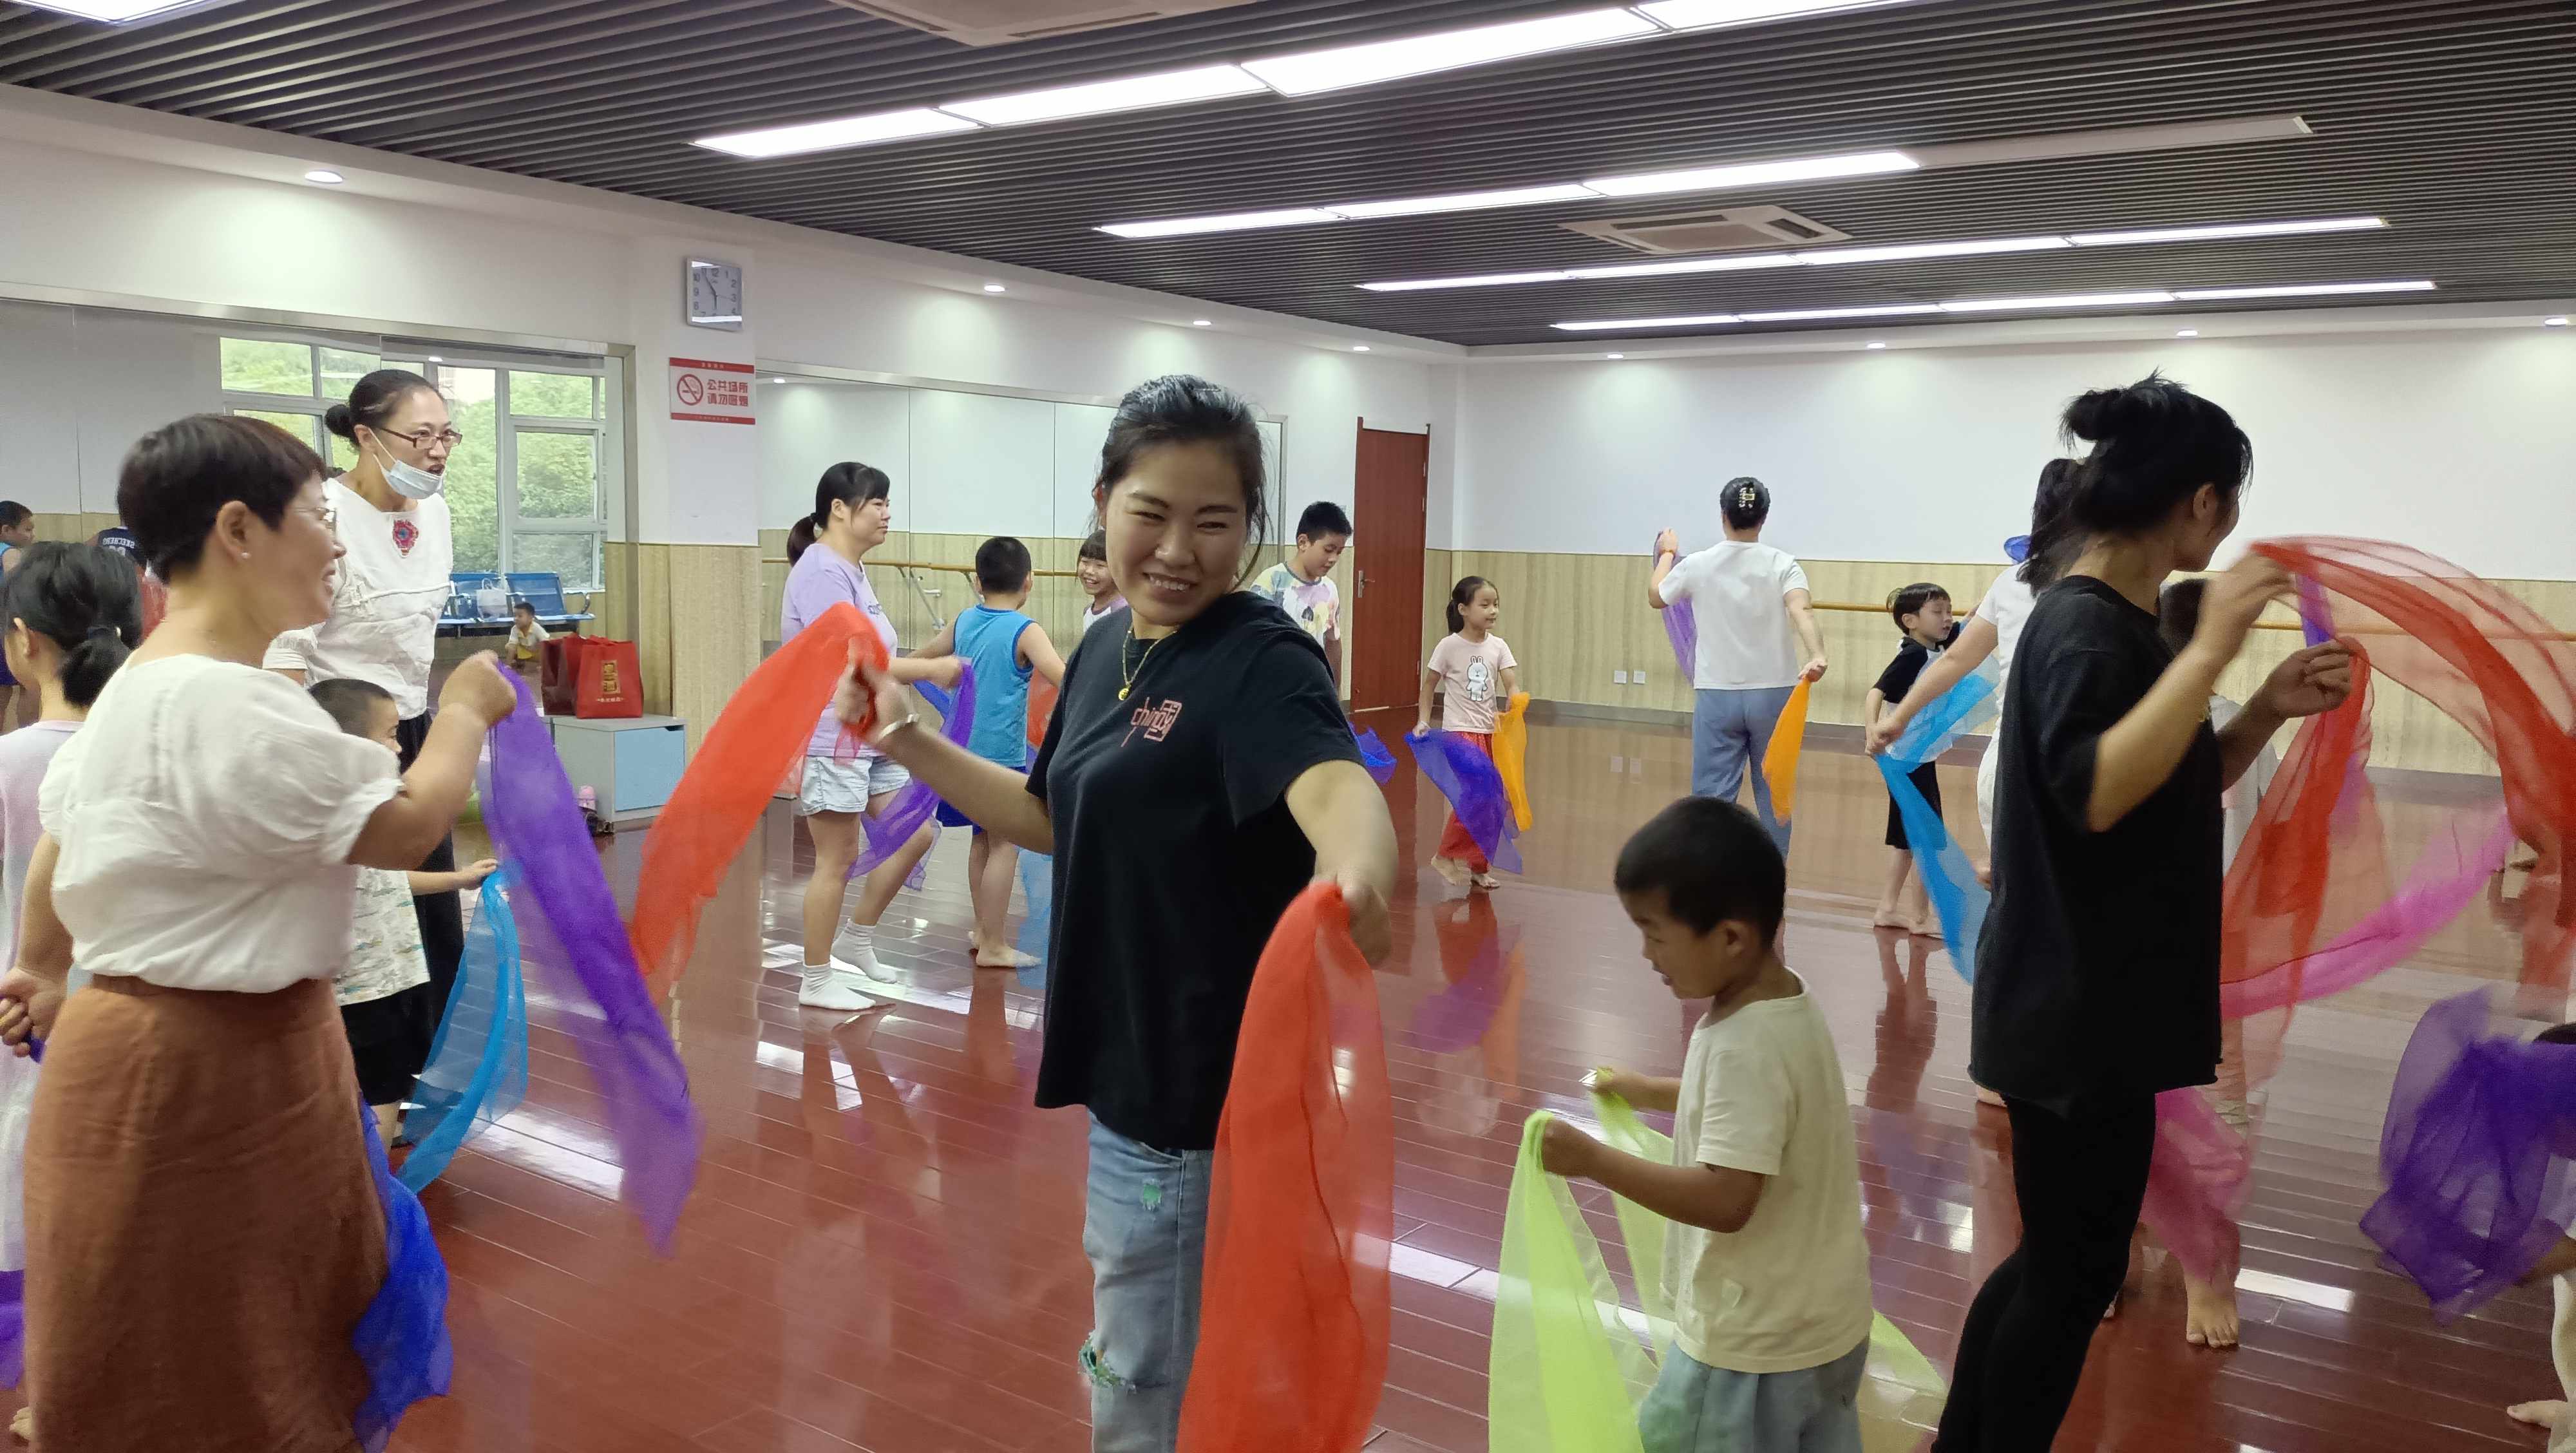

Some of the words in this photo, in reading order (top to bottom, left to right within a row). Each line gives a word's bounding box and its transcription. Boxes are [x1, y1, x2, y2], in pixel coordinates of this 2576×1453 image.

[732, 279, 737, 289] 2
[706, 379, 748, 393] 公共场所
